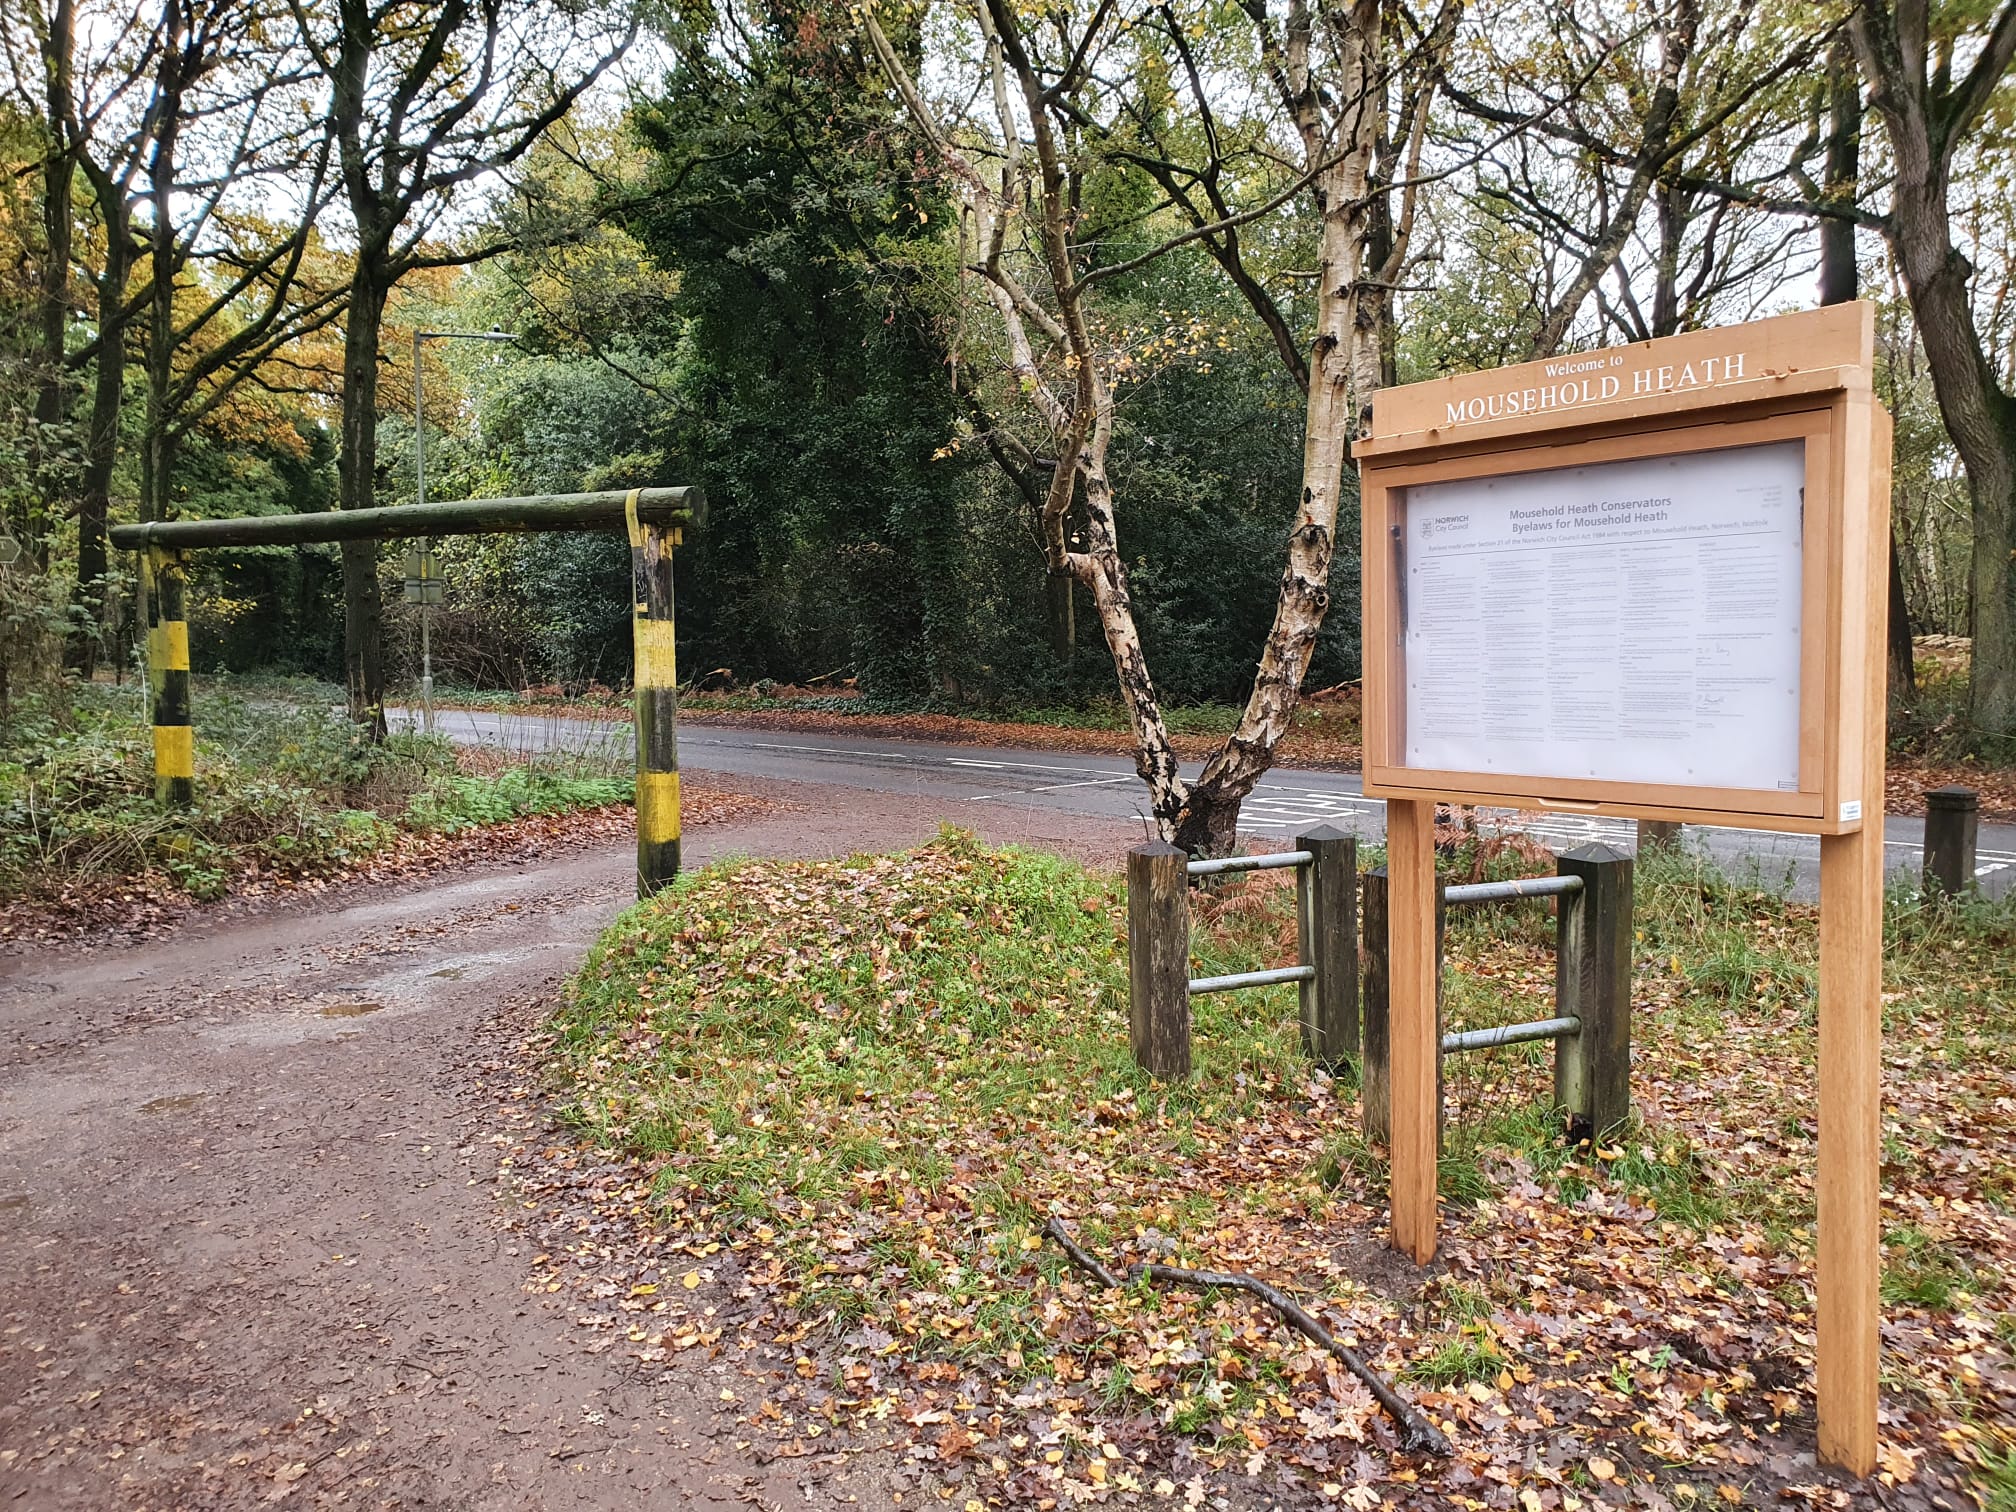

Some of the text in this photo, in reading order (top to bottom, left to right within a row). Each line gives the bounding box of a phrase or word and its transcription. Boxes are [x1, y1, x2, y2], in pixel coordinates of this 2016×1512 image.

[1545, 355, 1623, 378] Welcome to
[1446, 353, 1746, 423] MOUSEHOLD HEATH
[1435, 515, 1469, 525] NORWICH
[1509, 498, 1672, 520] Mousehold Heath Conservators
[1512, 510, 1668, 534] Byelaws for Mousehold Heath
